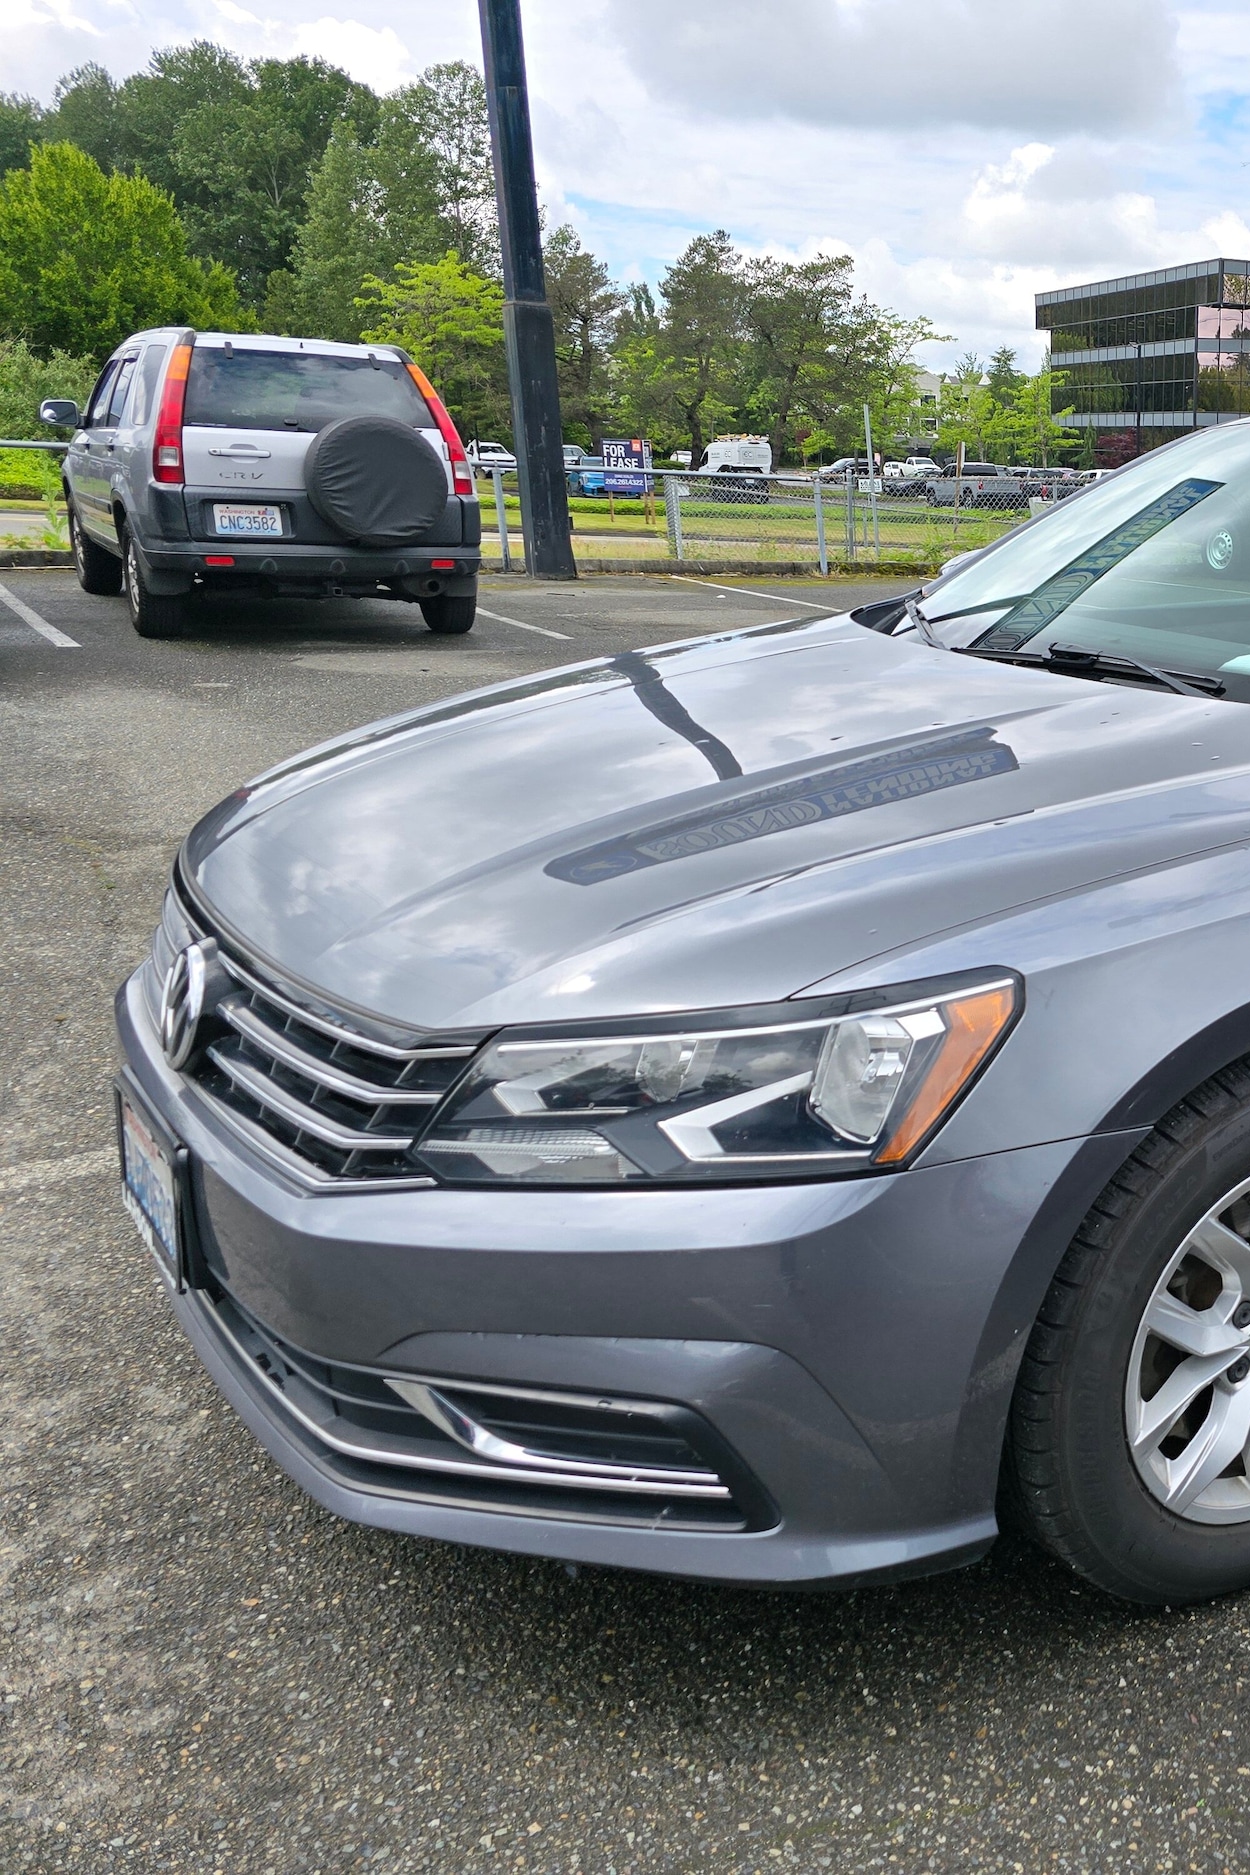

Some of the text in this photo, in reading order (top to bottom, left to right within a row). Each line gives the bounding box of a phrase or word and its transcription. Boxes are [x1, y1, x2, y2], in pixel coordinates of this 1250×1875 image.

[602, 444, 626, 457] FOR
[603, 457, 639, 469] LEASE
[220, 515, 278, 531] CNC3582
